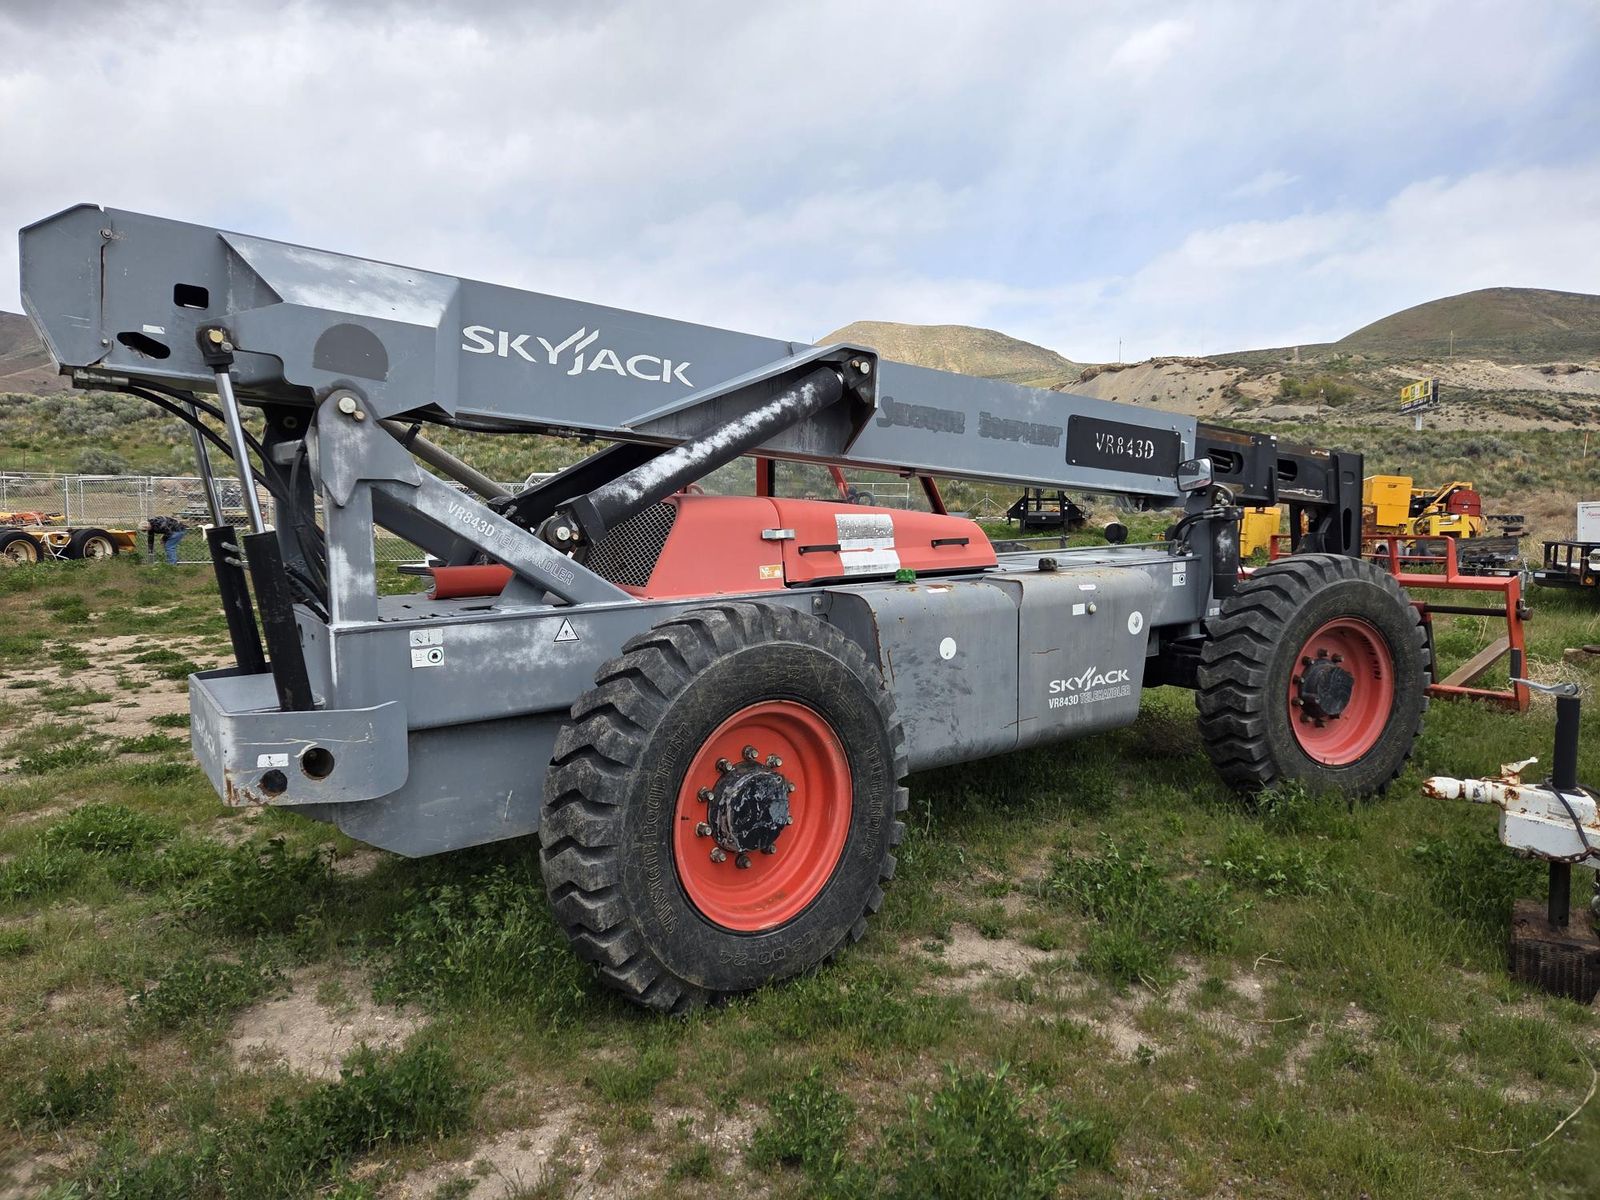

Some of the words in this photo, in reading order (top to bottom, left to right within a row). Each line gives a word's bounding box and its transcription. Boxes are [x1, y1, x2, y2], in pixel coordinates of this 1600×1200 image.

[462, 325, 695, 388] SKYJACK
[1095, 431, 1154, 460] VR843D
[447, 501, 495, 537] VR843D
[494, 529, 575, 586] TELEHANDLER
[1049, 666, 1130, 694] SKYJACK
[1048, 694, 1079, 709] VR843D
[1079, 684, 1131, 704] TELEHANDLER
